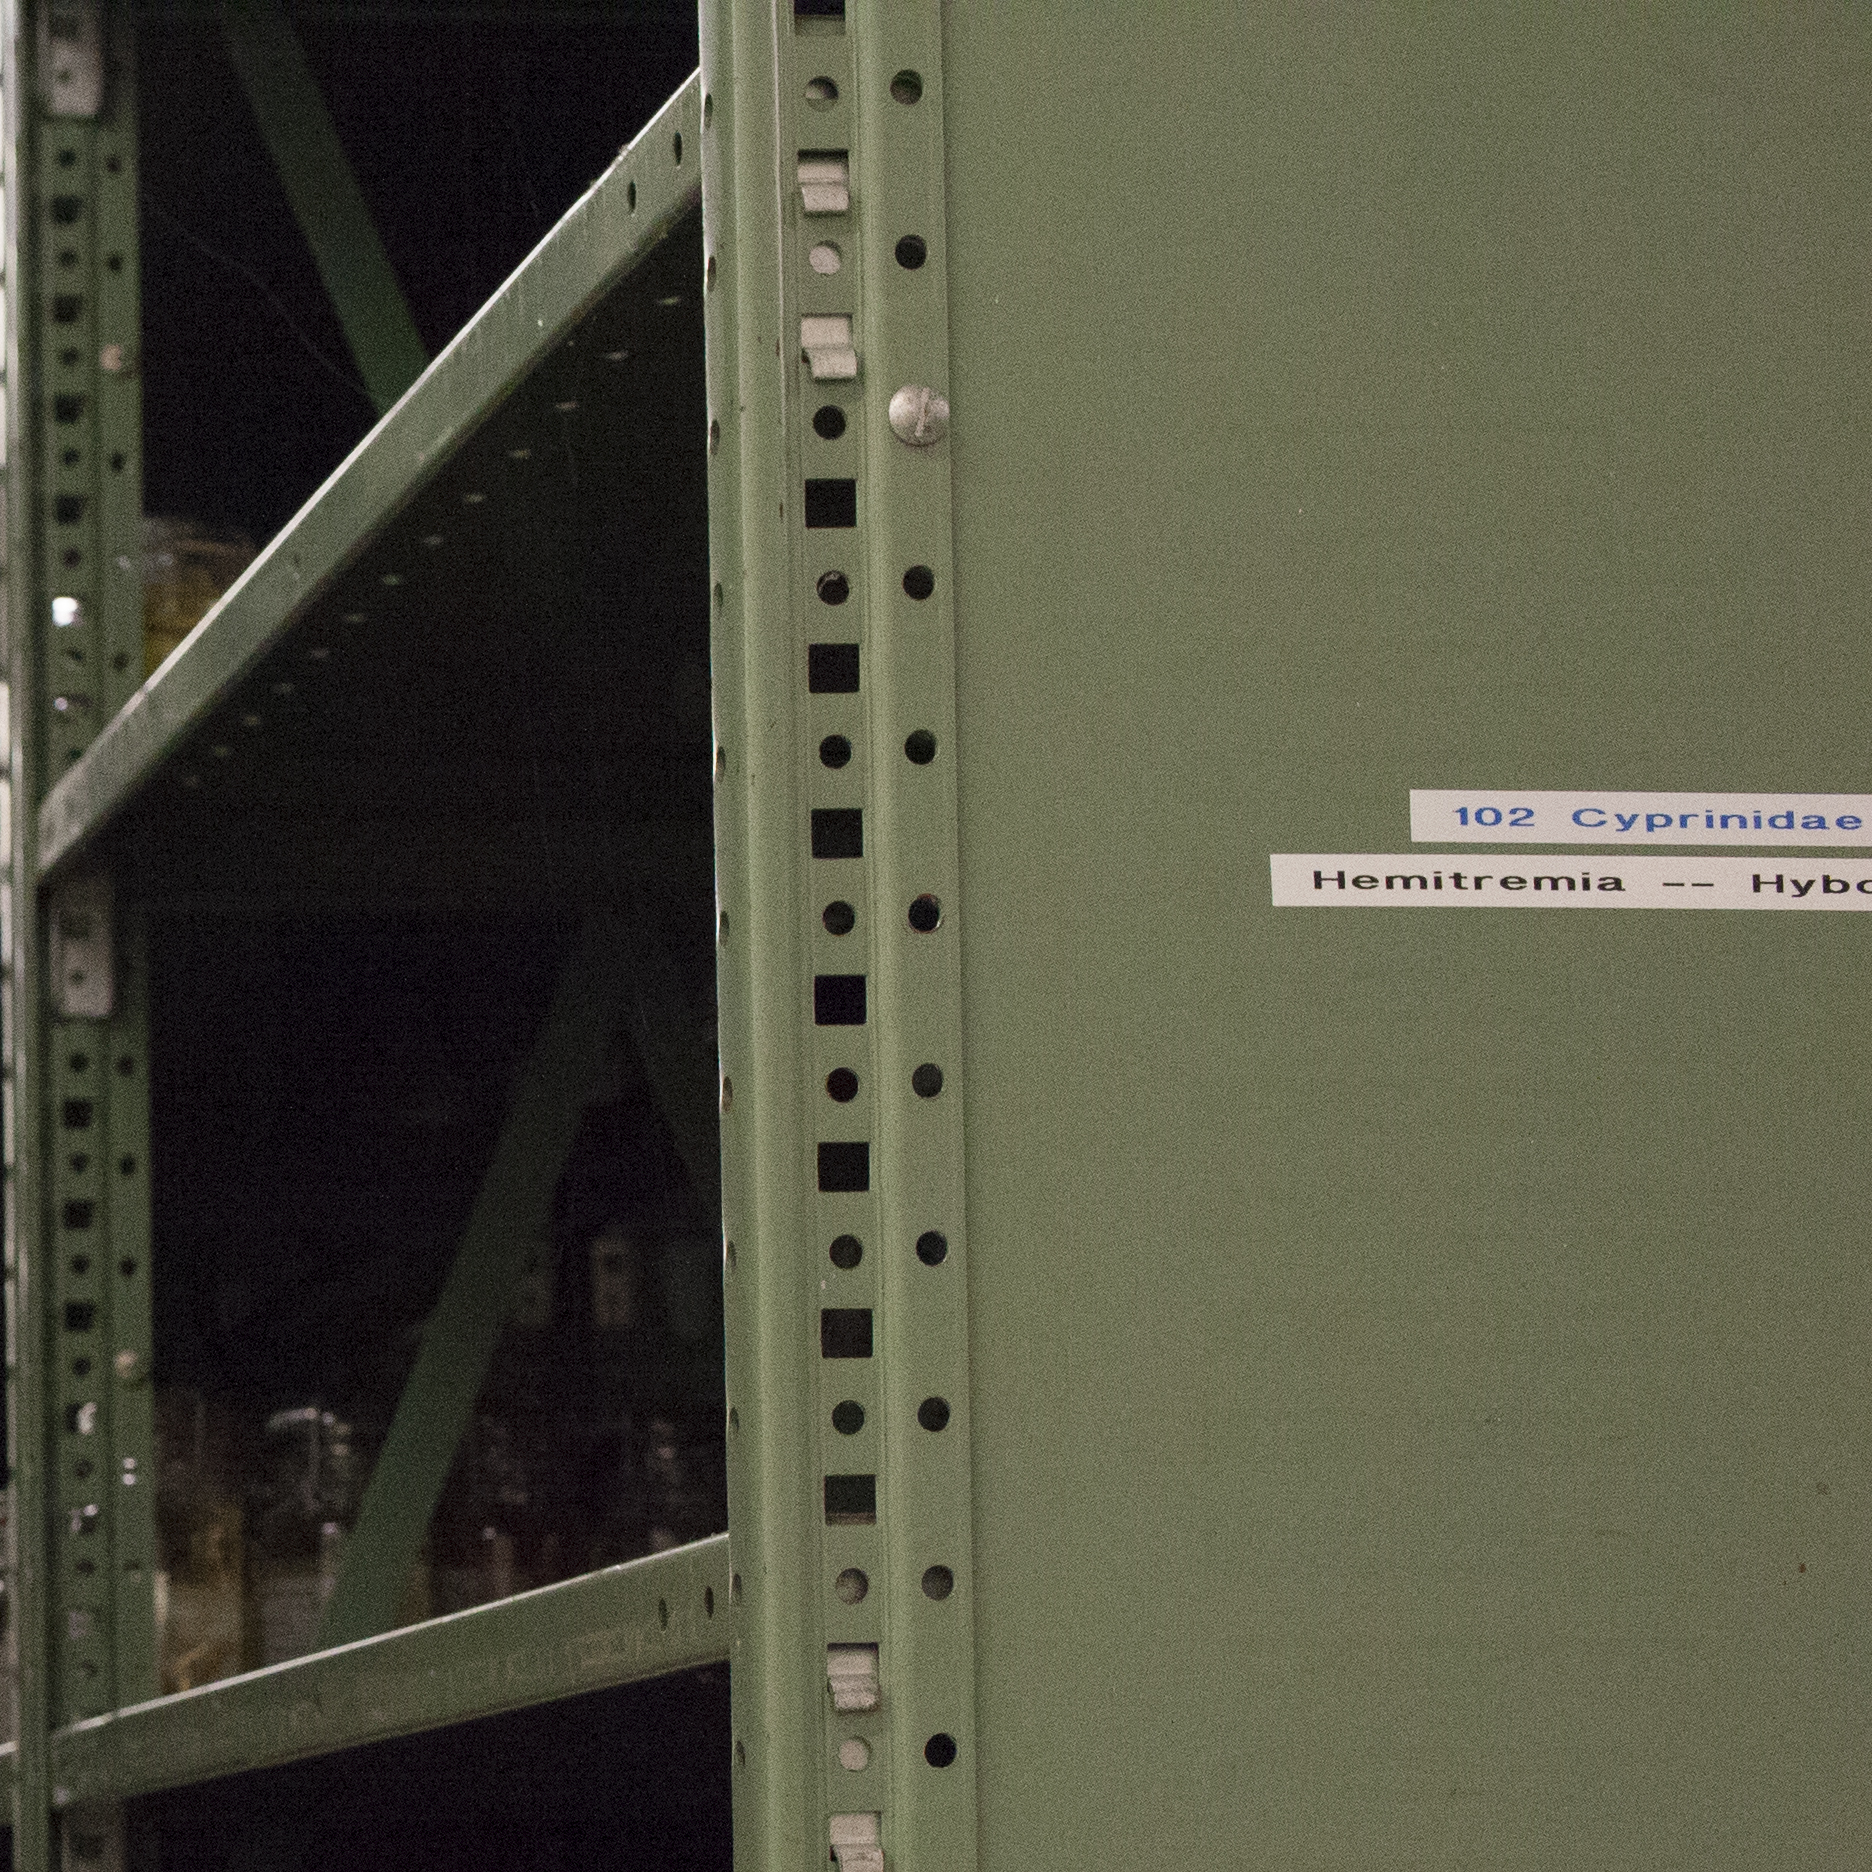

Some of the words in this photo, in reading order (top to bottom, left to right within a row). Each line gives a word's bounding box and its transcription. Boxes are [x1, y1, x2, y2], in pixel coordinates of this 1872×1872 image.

[1453, 806, 1535, 827] 102
[1571, 807, 1862, 832] Cyprinidae
[1313, 870, 1626, 892] Hemitremia
